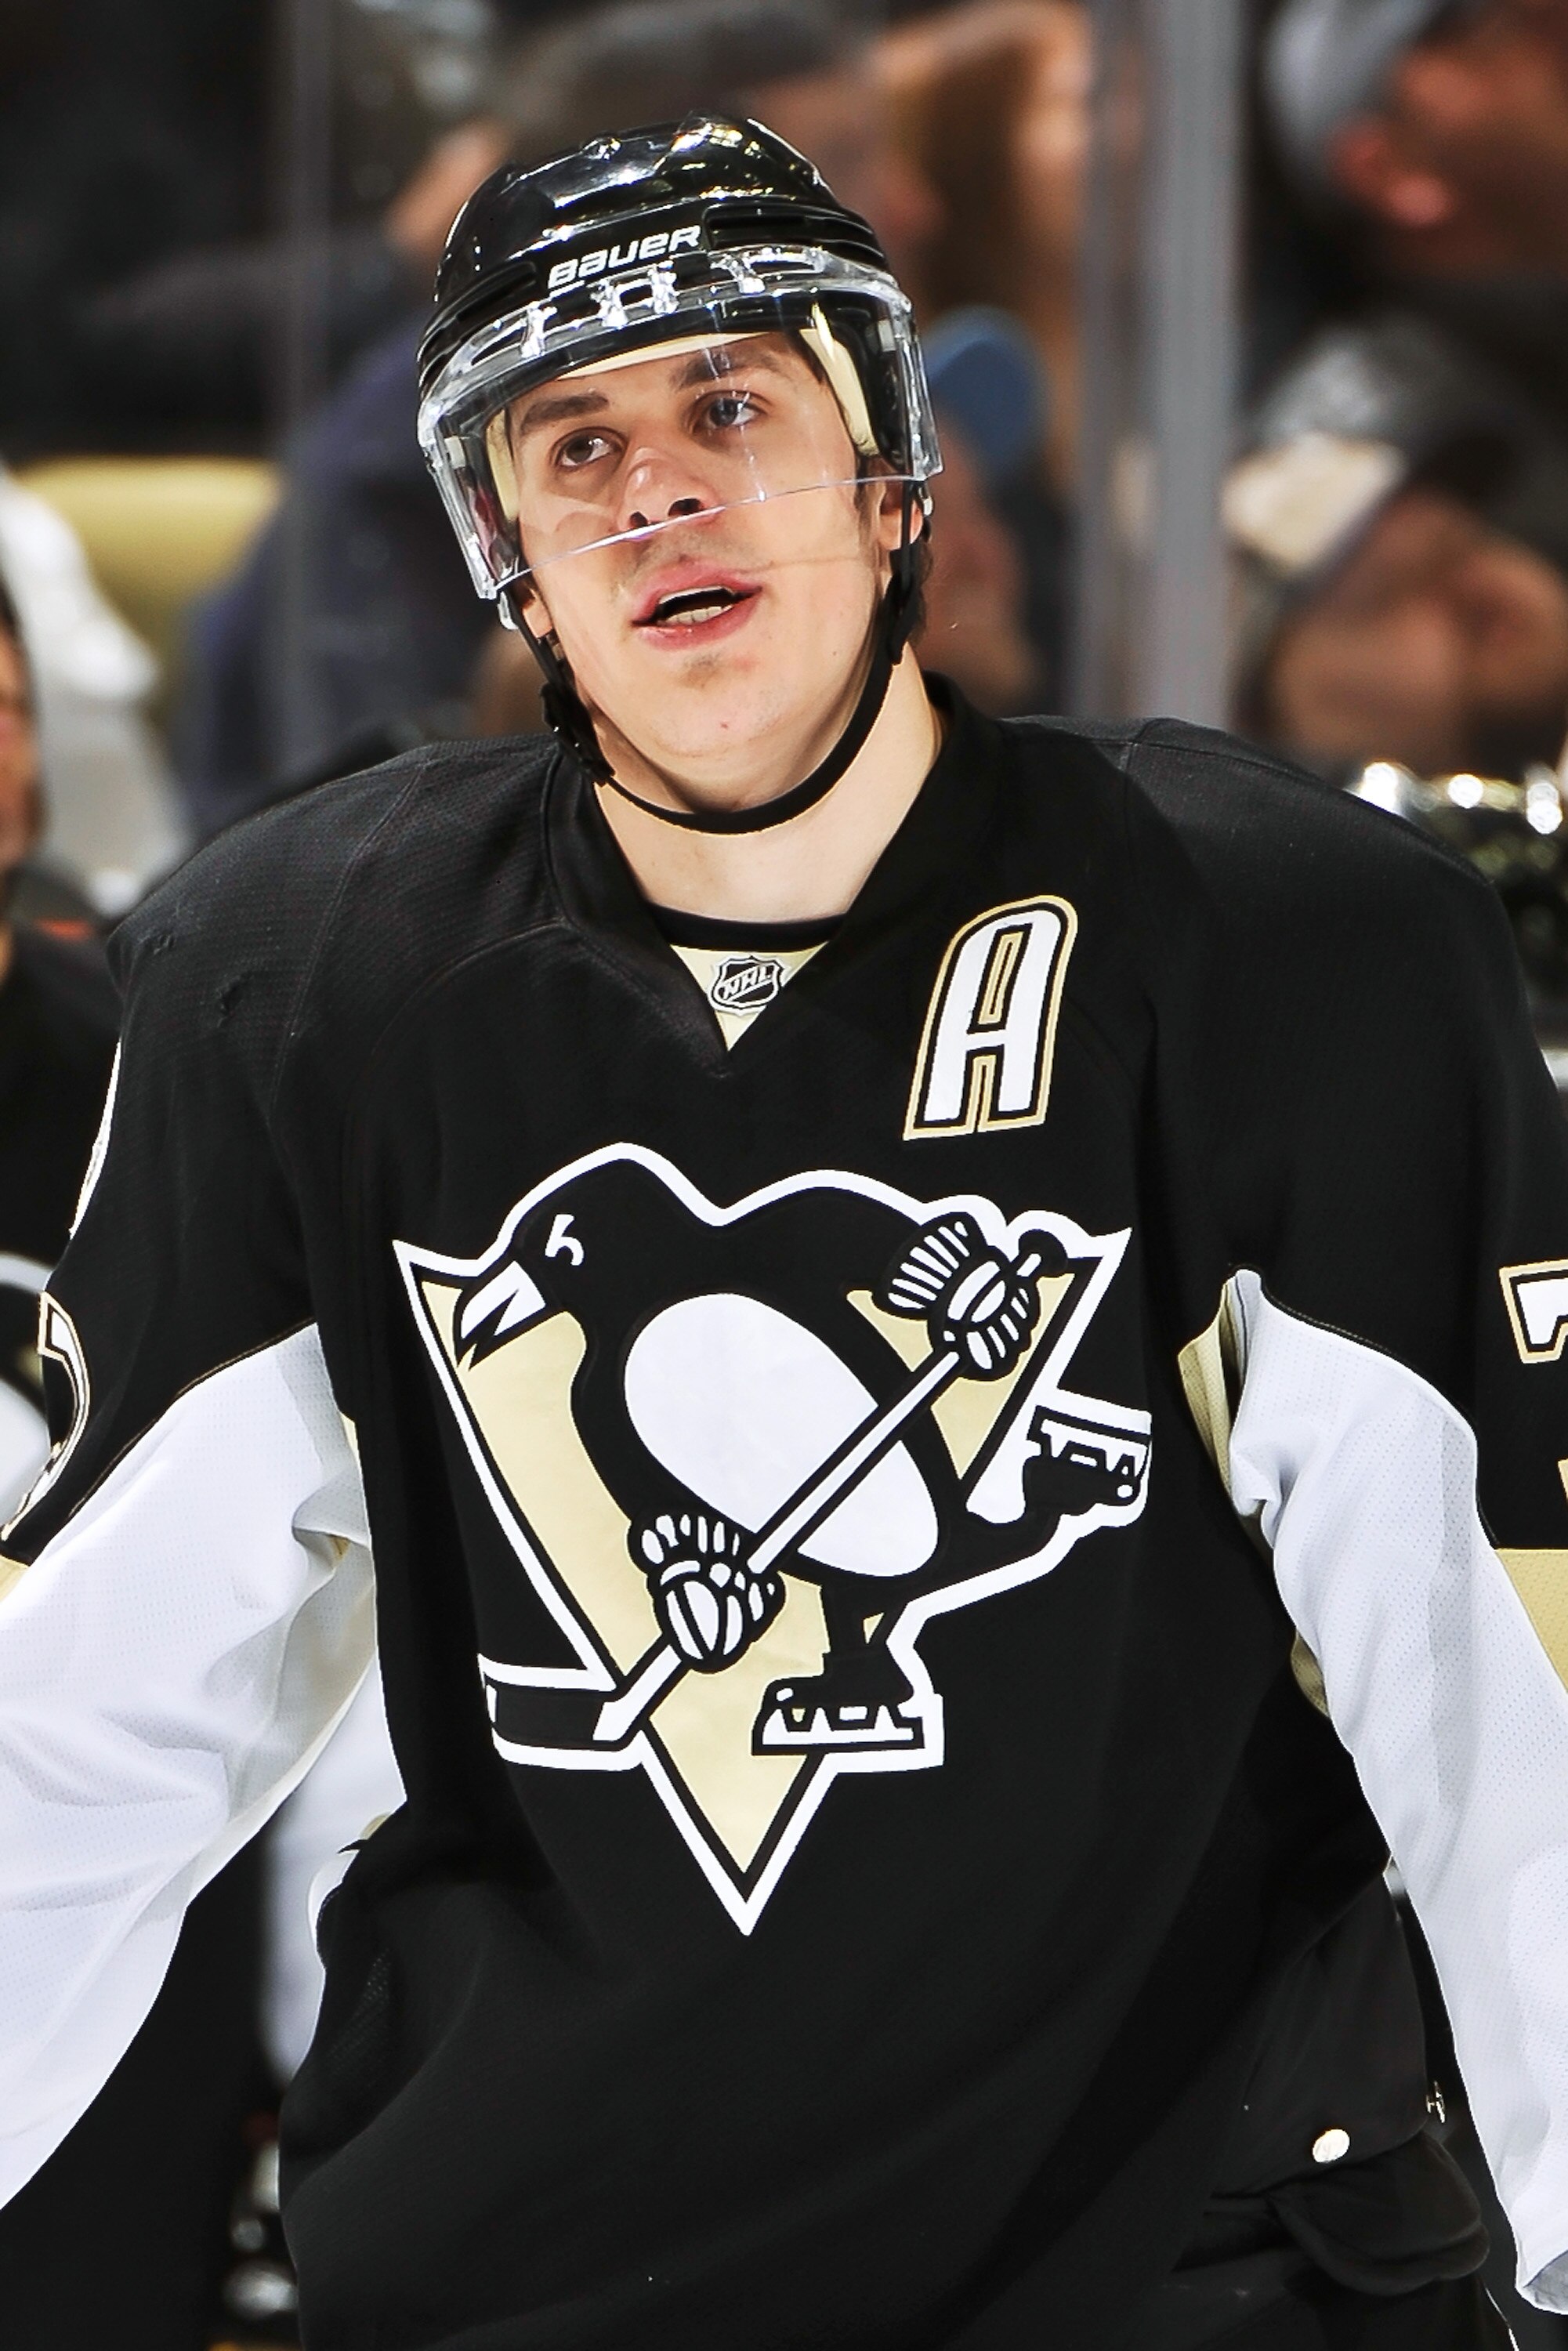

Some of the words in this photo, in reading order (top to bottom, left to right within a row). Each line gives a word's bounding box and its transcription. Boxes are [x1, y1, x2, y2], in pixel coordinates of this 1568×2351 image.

[548, 225, 701, 288] BAUER
[720, 964, 773, 1001] NHL
[903, 895, 1078, 1141] A
